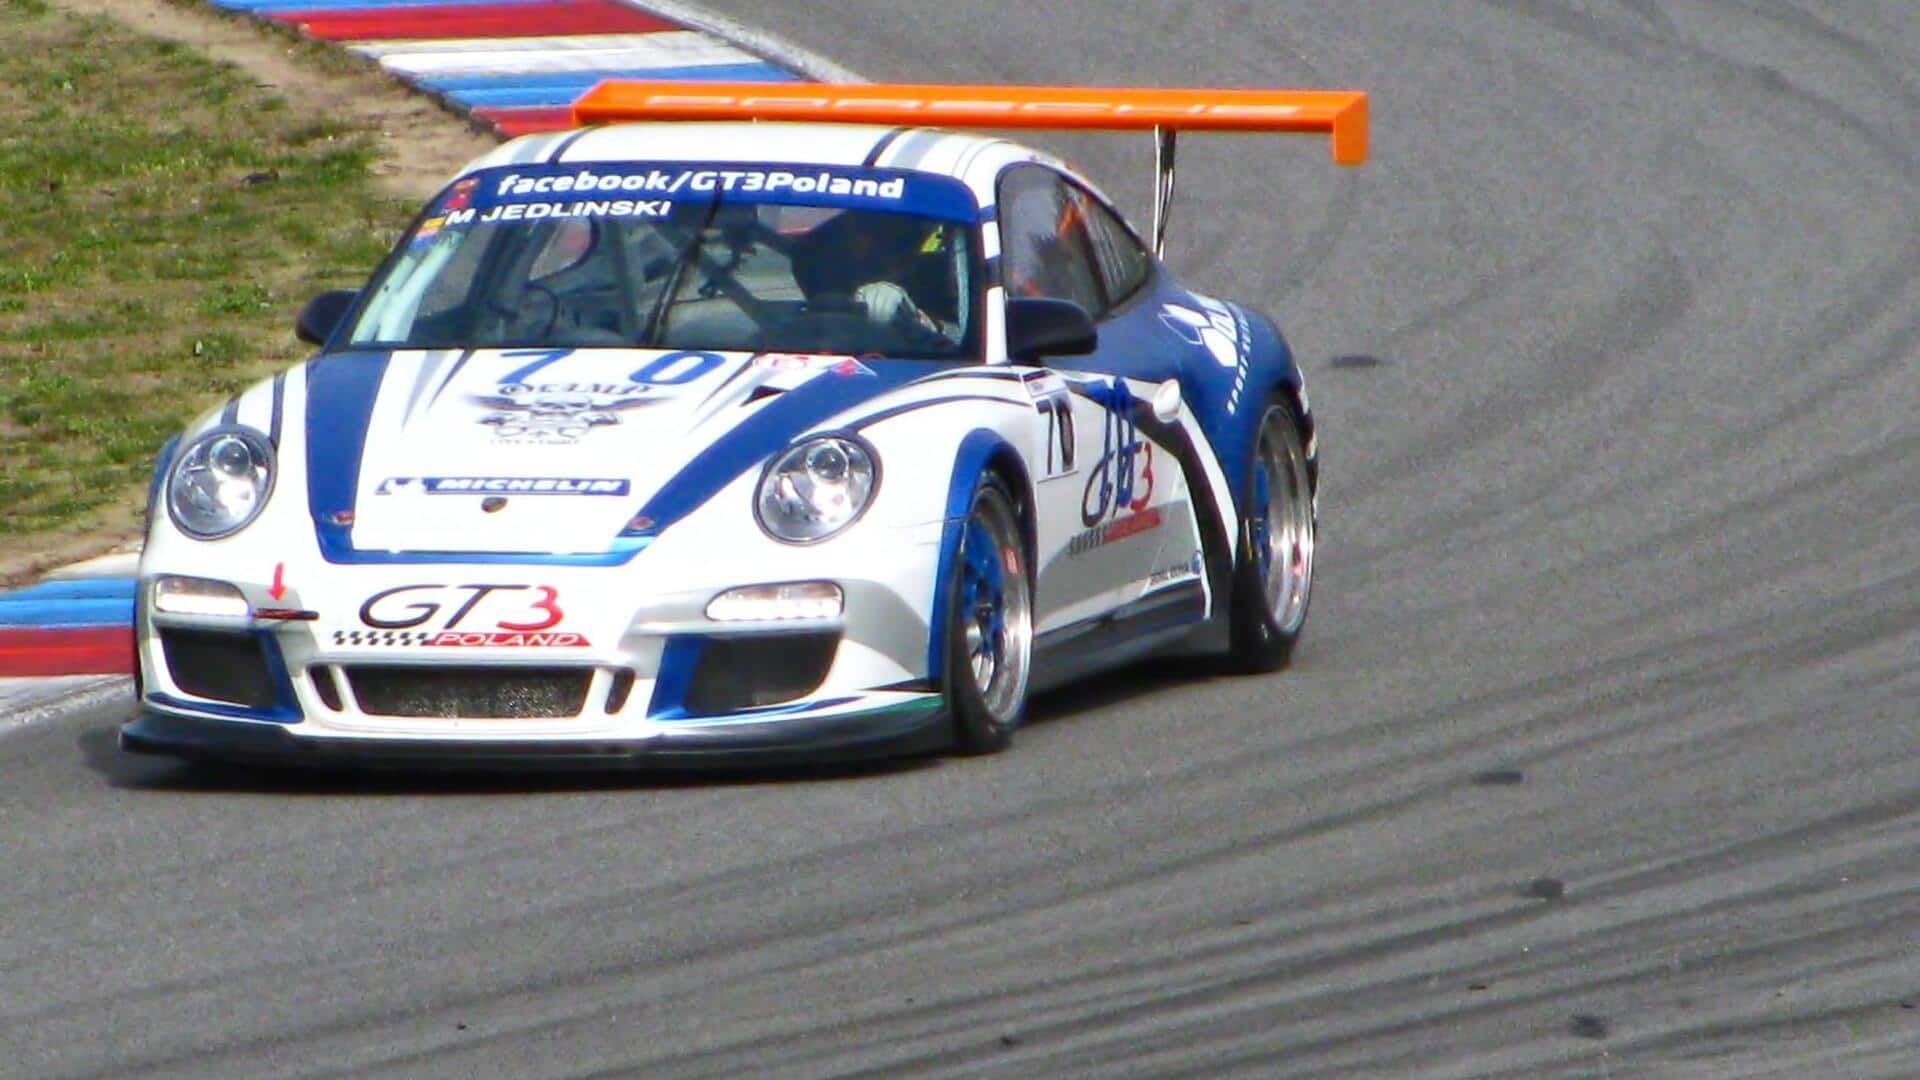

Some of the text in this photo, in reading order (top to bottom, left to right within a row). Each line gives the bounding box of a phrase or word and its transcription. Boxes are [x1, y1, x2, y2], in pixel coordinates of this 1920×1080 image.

[497, 171, 905, 199] facebook/GT3Poland
[445, 200, 672, 225] M JEDLINSKI
[435, 478, 623, 491] MICHELIN
[358, 584, 565, 631] GT3
[435, 633, 581, 647] POLAND
